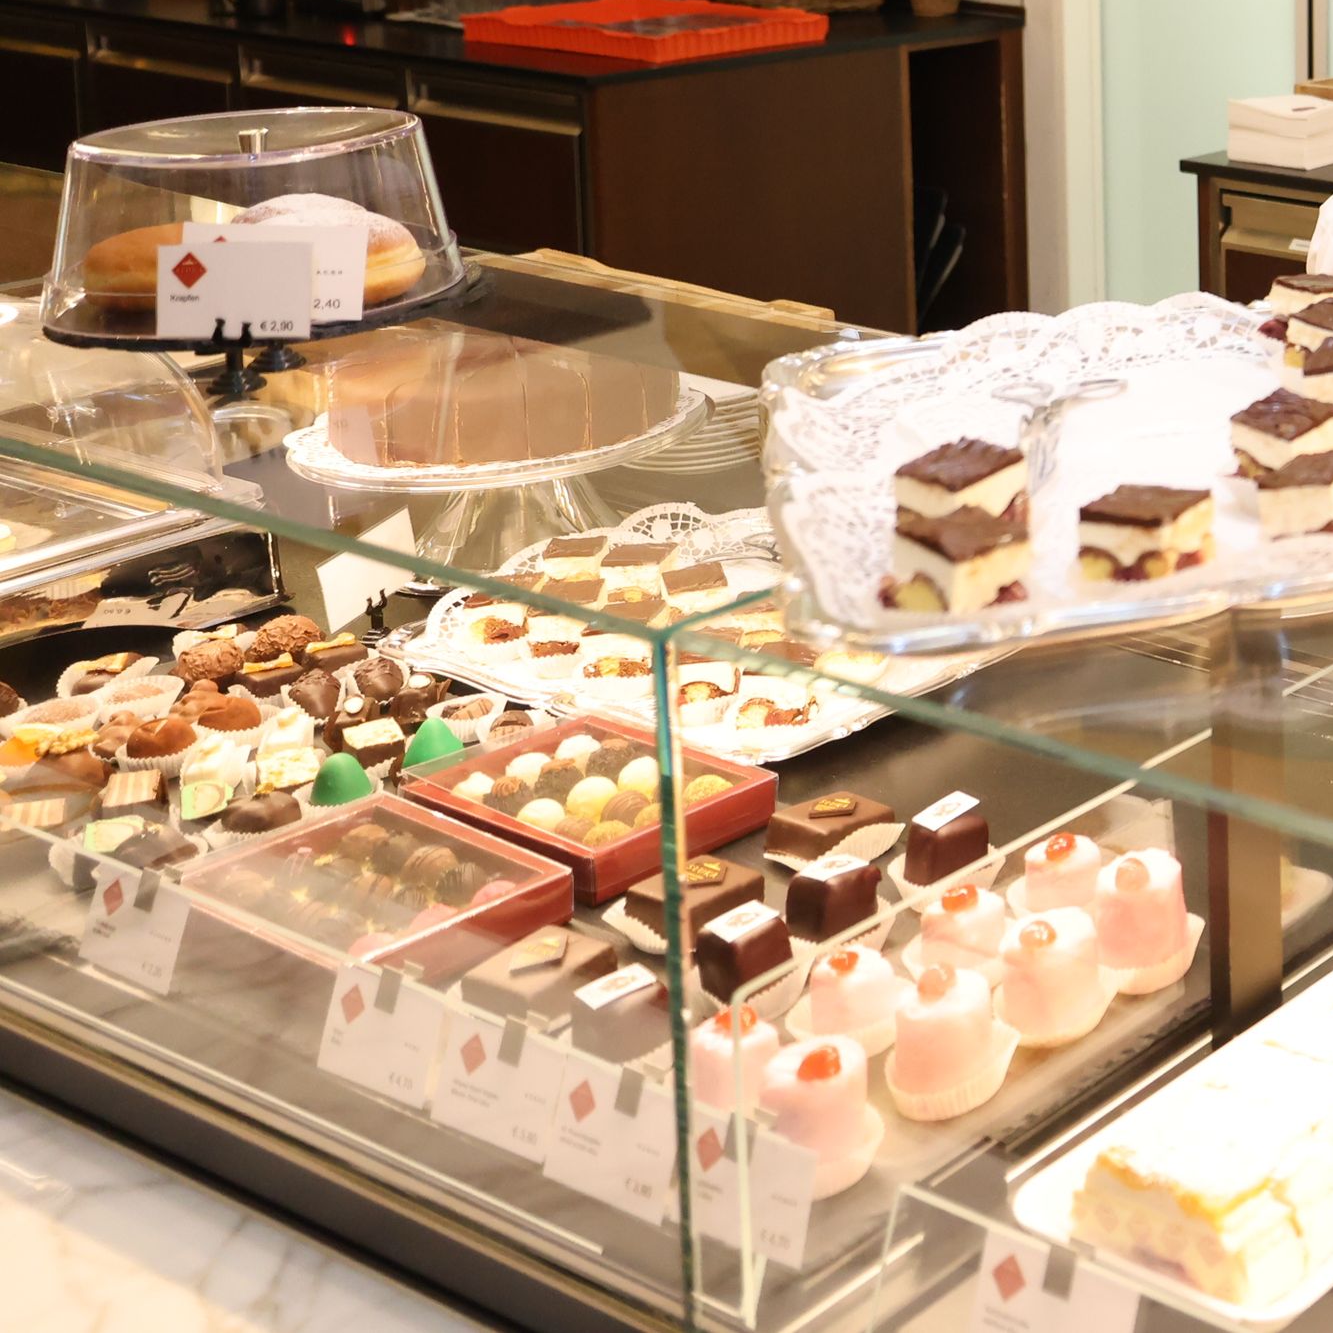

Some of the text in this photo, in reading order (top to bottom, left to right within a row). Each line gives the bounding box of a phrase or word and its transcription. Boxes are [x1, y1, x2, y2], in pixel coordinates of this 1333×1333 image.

[169, 294, 200, 303] Krapfen
[313, 298, 341, 310] 2,40
[259, 320, 294, 332] € 2,90
